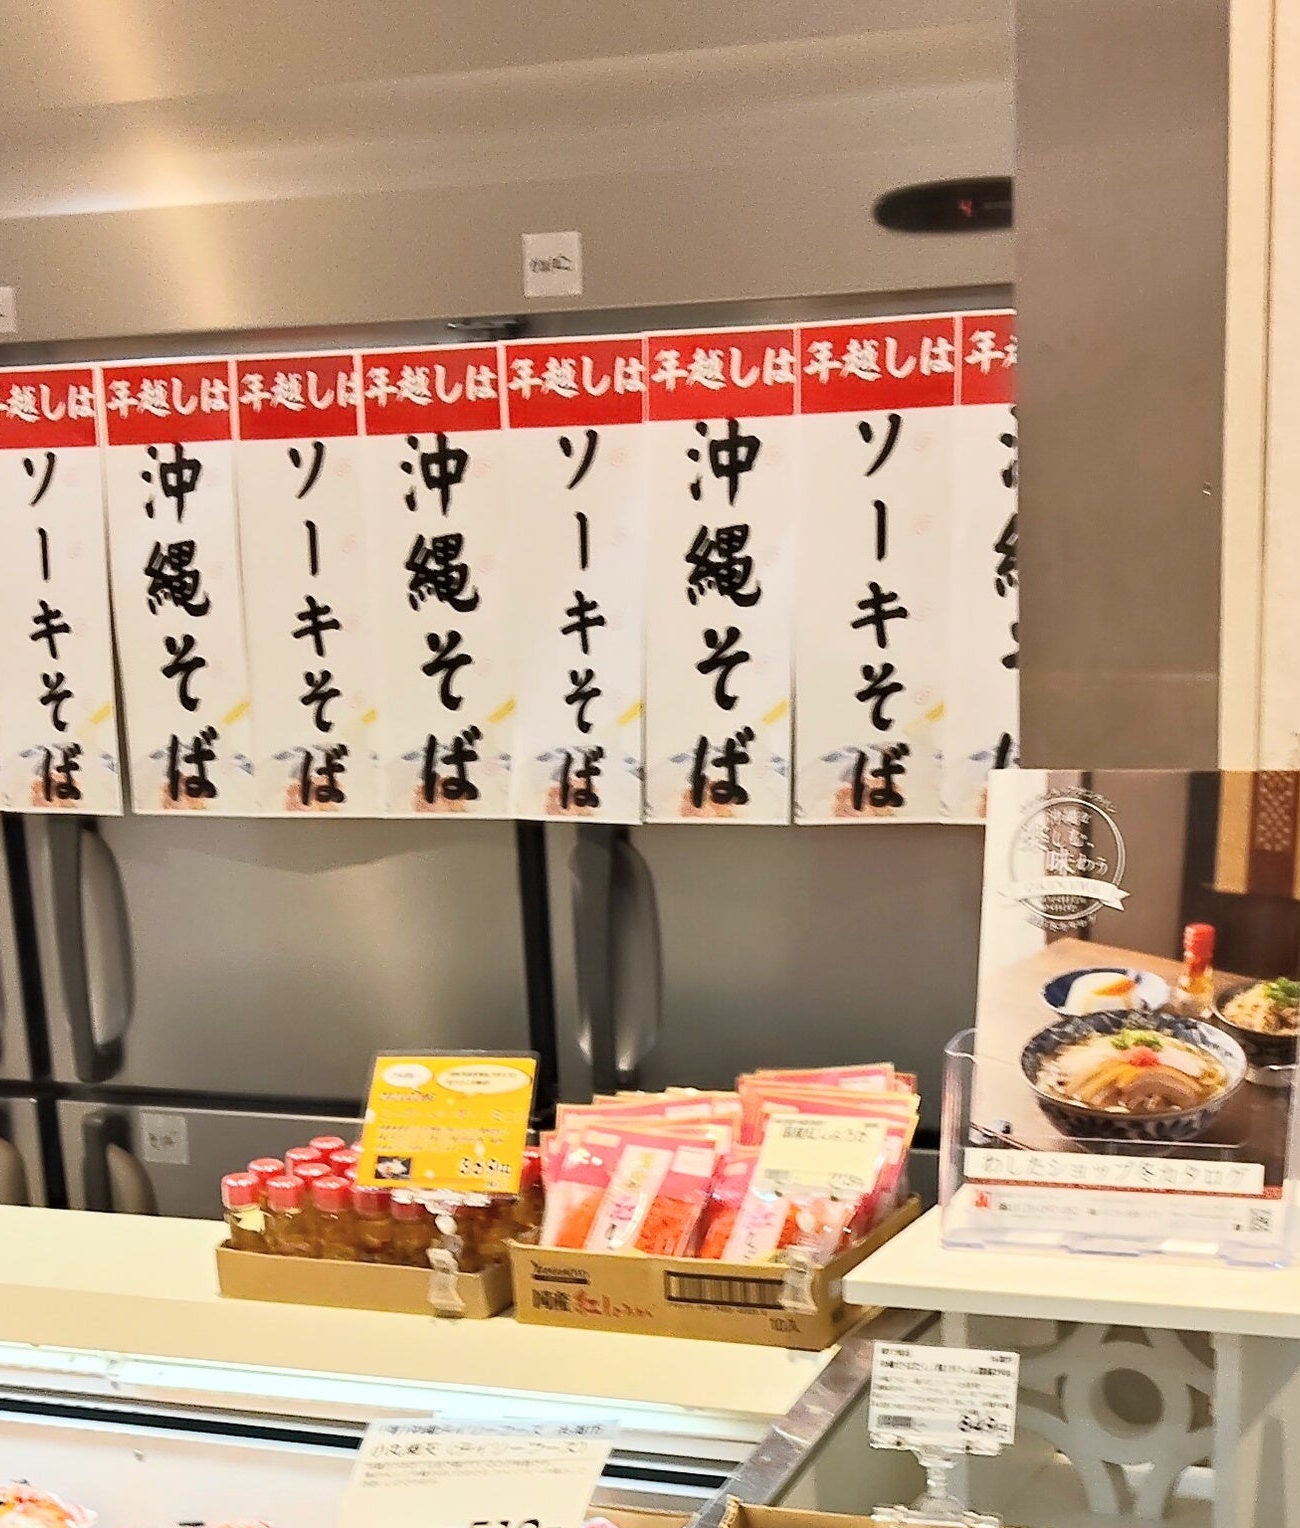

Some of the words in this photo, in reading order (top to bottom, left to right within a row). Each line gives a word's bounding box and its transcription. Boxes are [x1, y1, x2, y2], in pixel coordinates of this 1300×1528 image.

[106, 375, 231, 420] 年越しは
[364, 364, 499, 407] 年越しは
[507, 354, 645, 399] 年越しは
[652, 345, 797, 392] 年越しは
[802, 337, 955, 383] 年越しは
[22, 451, 82, 803] ソーキそば
[141, 442, 219, 803] 沖縄そば
[288, 441, 349, 805] ソーキそば
[400, 431, 482, 805] 沖縄そば
[558, 429, 606, 810] ソーキそば
[685, 418, 763, 808] 沖縄そば
[850, 411, 910, 810] ソーキそば
